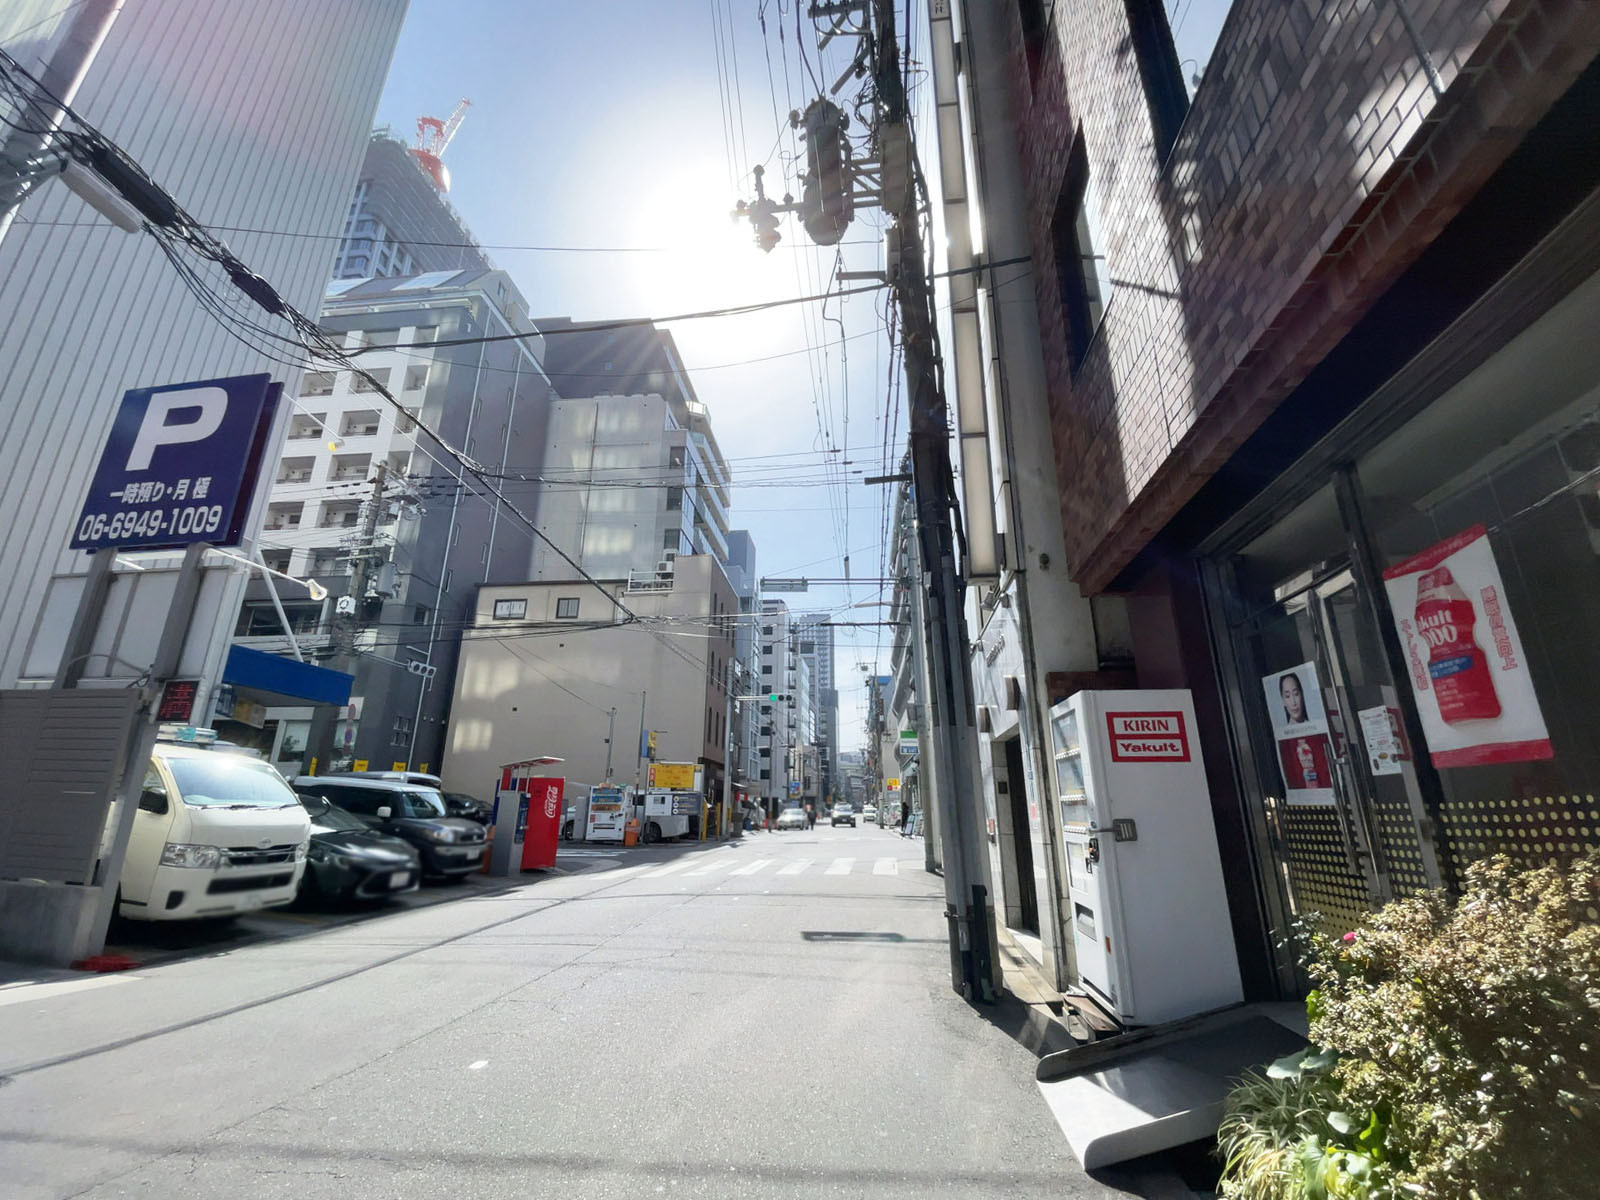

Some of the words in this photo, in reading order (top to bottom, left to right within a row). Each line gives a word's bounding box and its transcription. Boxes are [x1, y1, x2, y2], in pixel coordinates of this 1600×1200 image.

[125, 386, 228, 471] P
[78, 505, 223, 542] 06-6949-1009
[1123, 720, 1169, 732] KIRIN
[1120, 743, 1179, 753] Yakult
